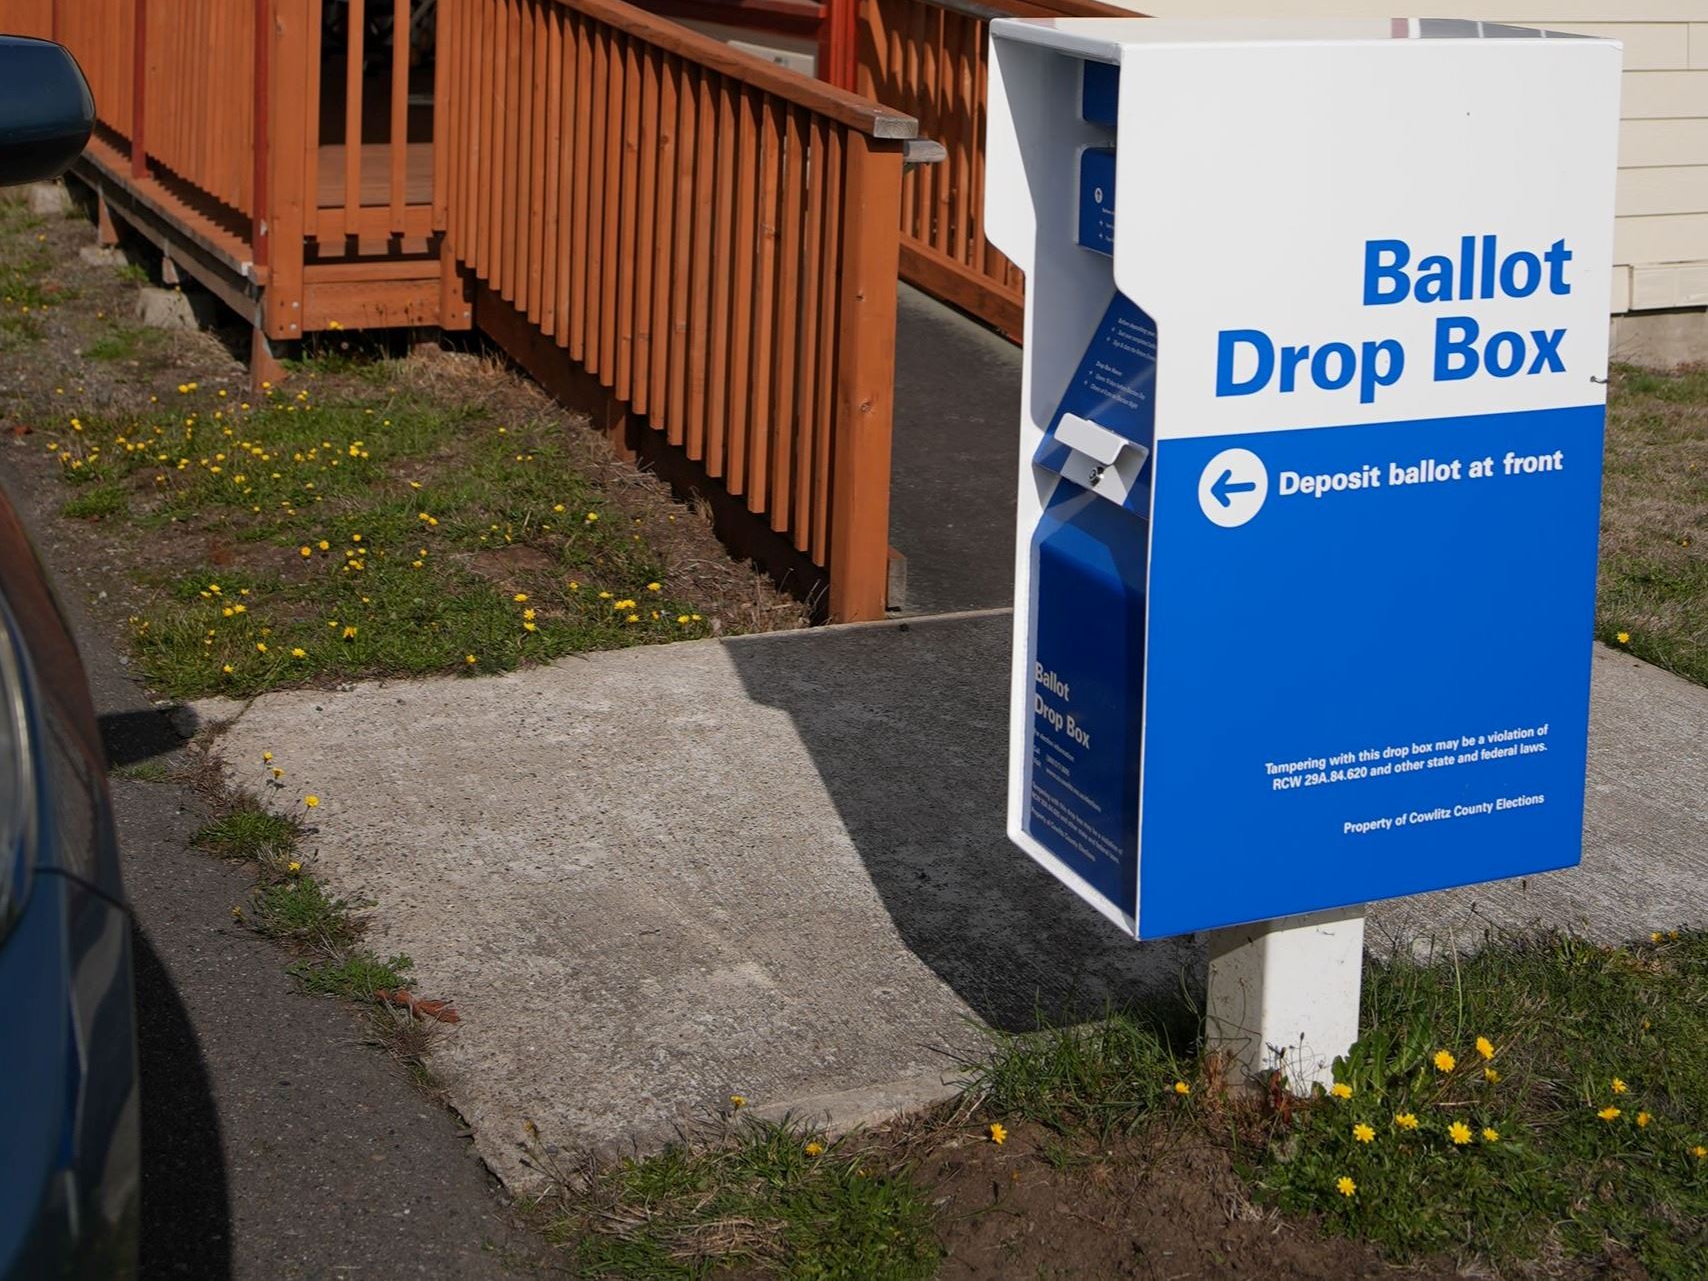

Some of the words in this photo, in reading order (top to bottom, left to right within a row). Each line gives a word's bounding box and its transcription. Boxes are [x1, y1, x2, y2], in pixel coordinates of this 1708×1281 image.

[1364, 235, 1572, 306] Ballot
[1215, 330, 1405, 404] Drop
[1434, 317, 1566, 382] Box
[1280, 464, 1381, 498] Deposit
[1389, 458, 1461, 486] ballot
[1469, 456, 1493, 478] at
[1503, 450, 1563, 475] front
[1035, 662, 1070, 702] Ballot
[1035, 693, 1063, 732] Drop
[1066, 715, 1090, 750] Box
[1265, 757, 1326, 776] Tampering
[1329, 751, 1356, 767] with
[1358, 748, 1380, 763] this
[1382, 745, 1410, 759] drop
[1411, 742, 1433, 755] box
[1435, 738, 1459, 752] may
[1461, 735, 1476, 748] be
[1477, 735, 1485, 745] a
[1487, 727, 1535, 744] violation
[1536, 723, 1549, 737] of
[1272, 775, 1302, 791] RCW
[1304, 766, 1368, 787] 29A.84.620
[1369, 764, 1392, 777] and
[1394, 760, 1425, 774] other
[1427, 755, 1455, 769] state
[1457, 750, 1479, 765] and
[1480, 744, 1518, 761] federal
[1519, 742, 1548, 755] laws.
[1343, 817, 1393, 835] Property
[1394, 813, 1408, 827] of
[1408, 807, 1452, 825] Cowlitz
[1453, 802, 1494, 818] County
[1495, 794, 1546, 811] Elections
